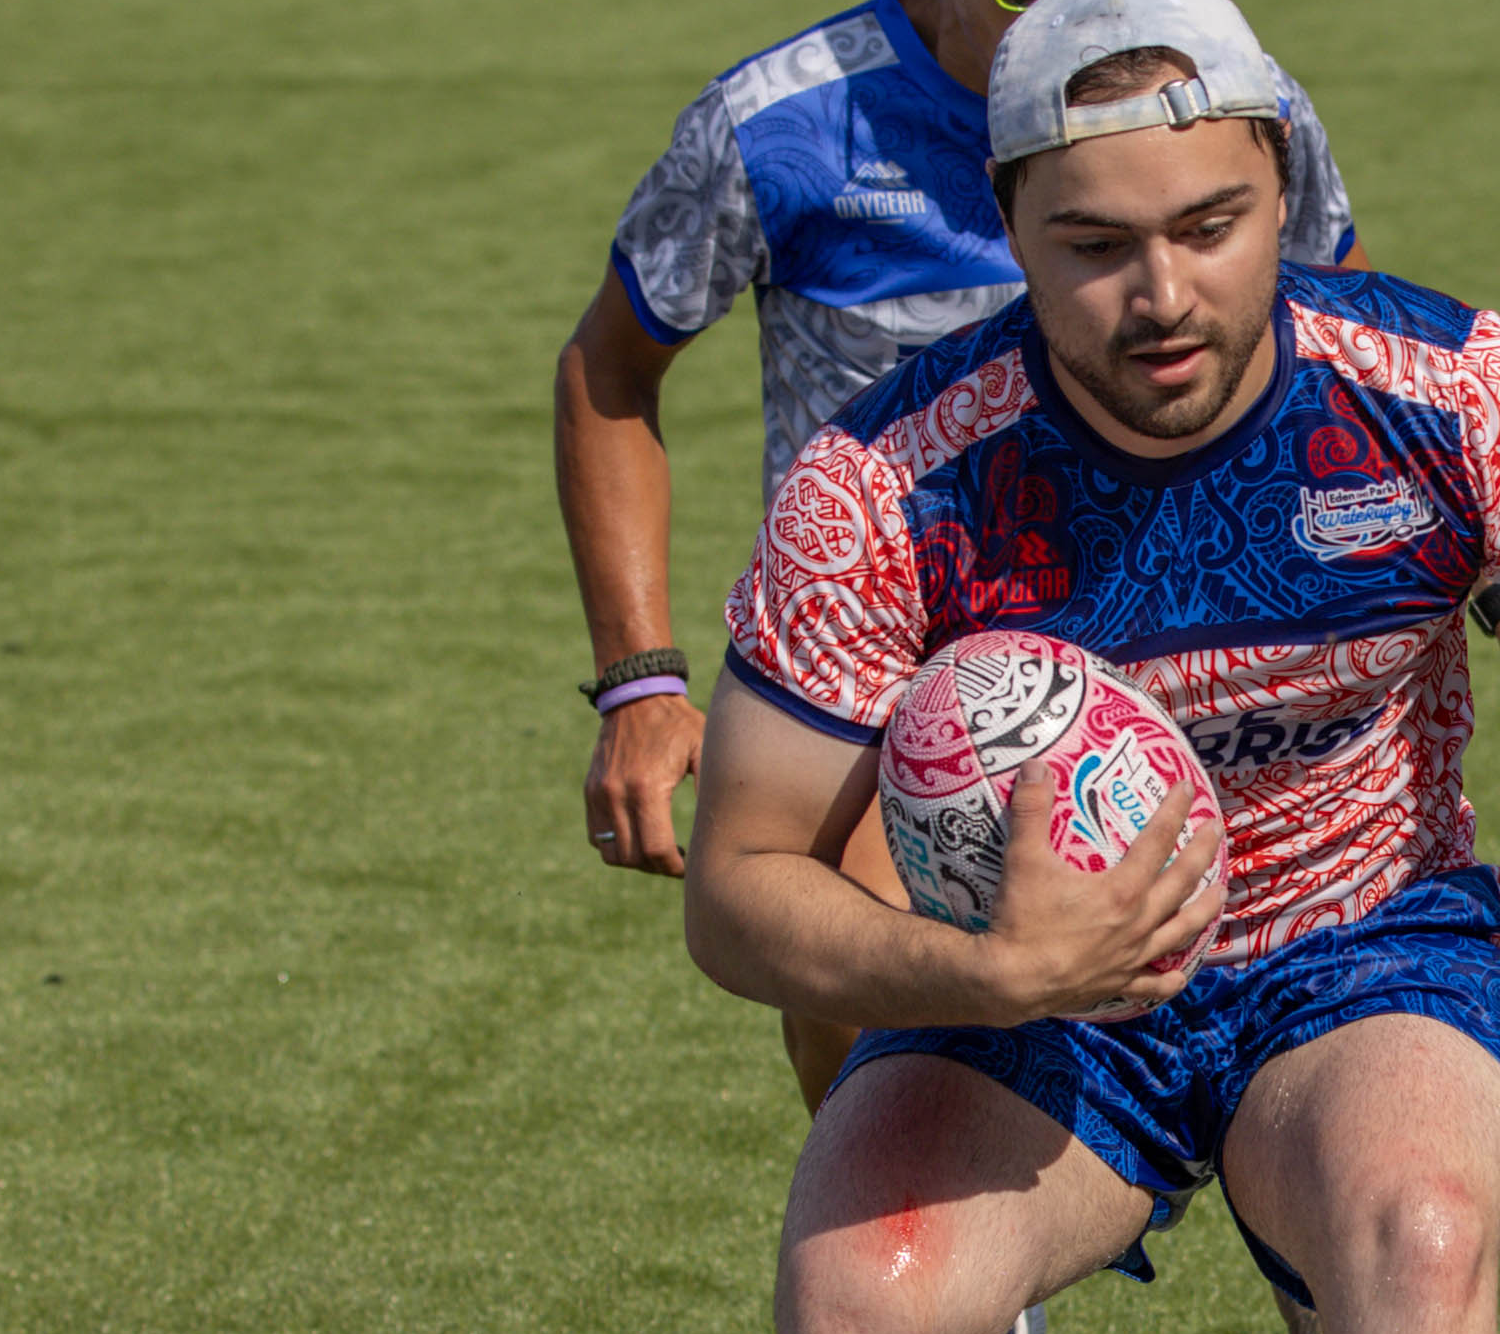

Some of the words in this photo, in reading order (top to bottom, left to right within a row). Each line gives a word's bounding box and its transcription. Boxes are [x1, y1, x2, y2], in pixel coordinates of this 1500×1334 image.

[833, 189, 927, 220] OXYGEAR
[1329, 491, 1355, 503] Eden
[1369, 482, 1394, 495] Park
[1316, 500, 1412, 528] WateRugby
